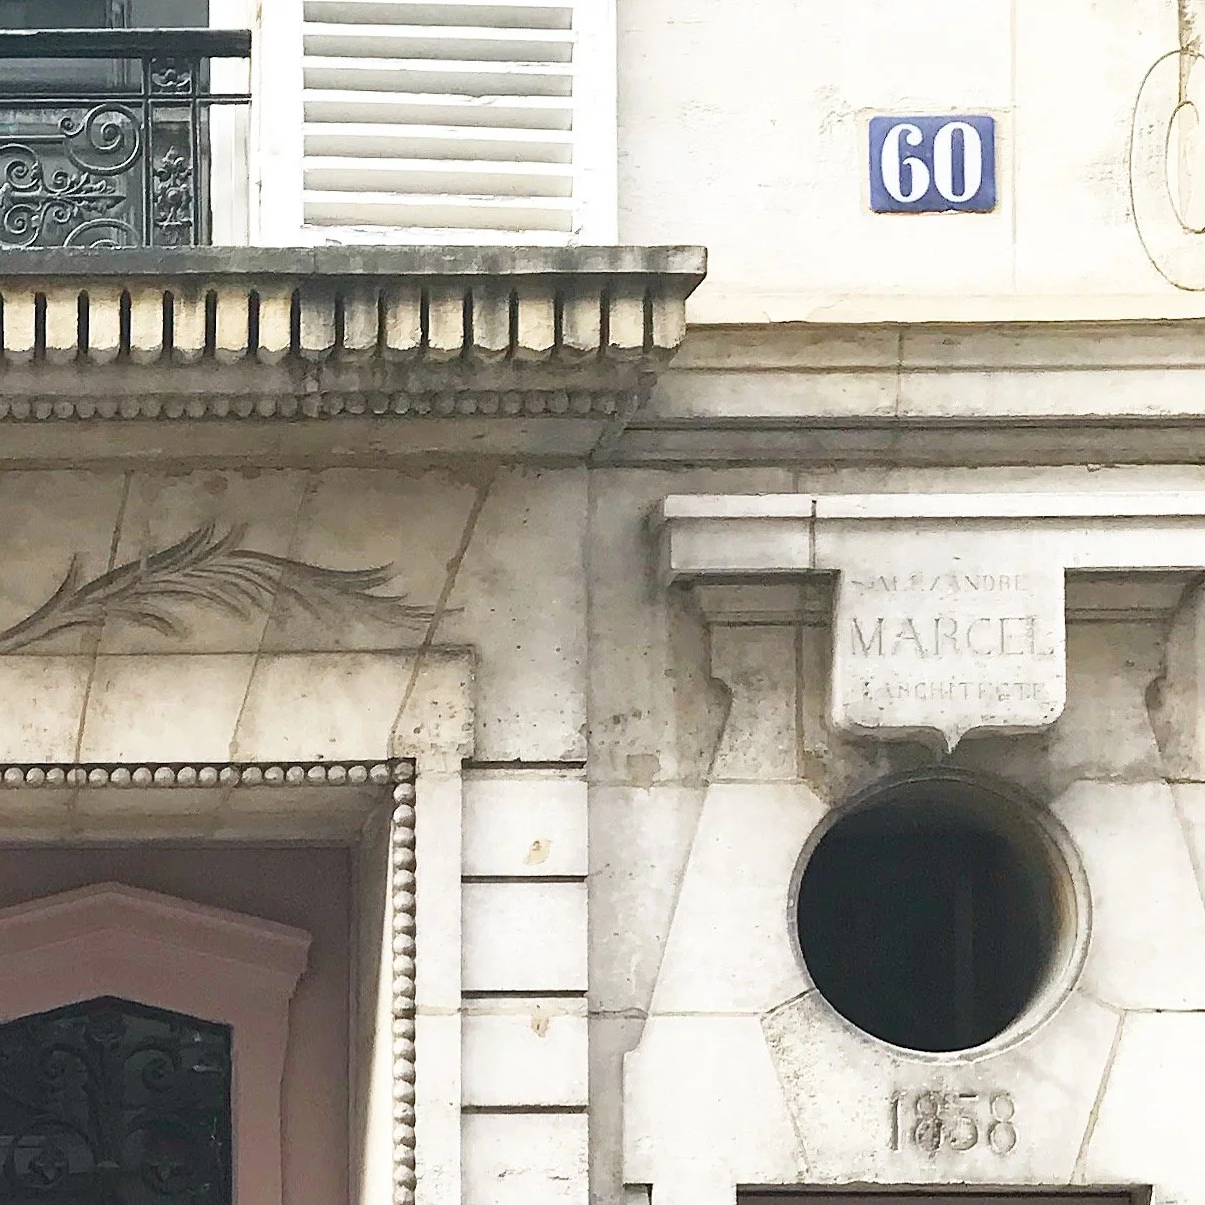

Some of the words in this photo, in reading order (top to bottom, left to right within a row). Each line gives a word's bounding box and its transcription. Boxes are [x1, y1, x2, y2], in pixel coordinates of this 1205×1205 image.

[881, 121, 982, 203] 60
[851, 617, 1054, 656] MARCEL
[889, 1089, 1018, 1154] 1858
